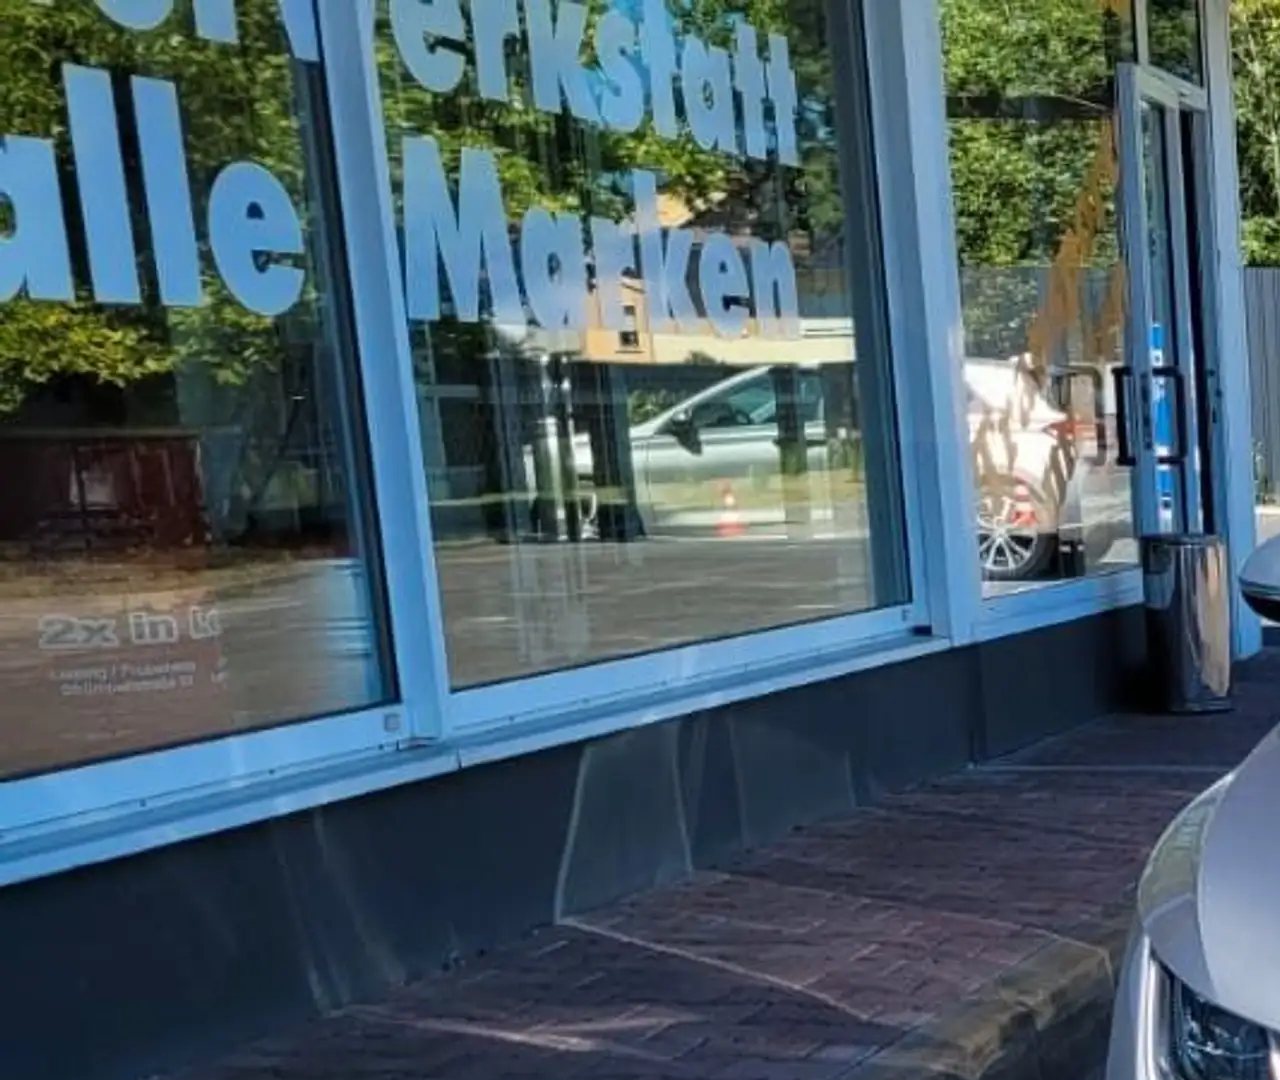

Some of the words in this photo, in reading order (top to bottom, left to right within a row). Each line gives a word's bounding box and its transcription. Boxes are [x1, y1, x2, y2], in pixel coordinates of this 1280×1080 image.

[0, 62, 304, 316] alle
[402, 135, 801, 341] Marken
[129, 612, 178, 644] in
